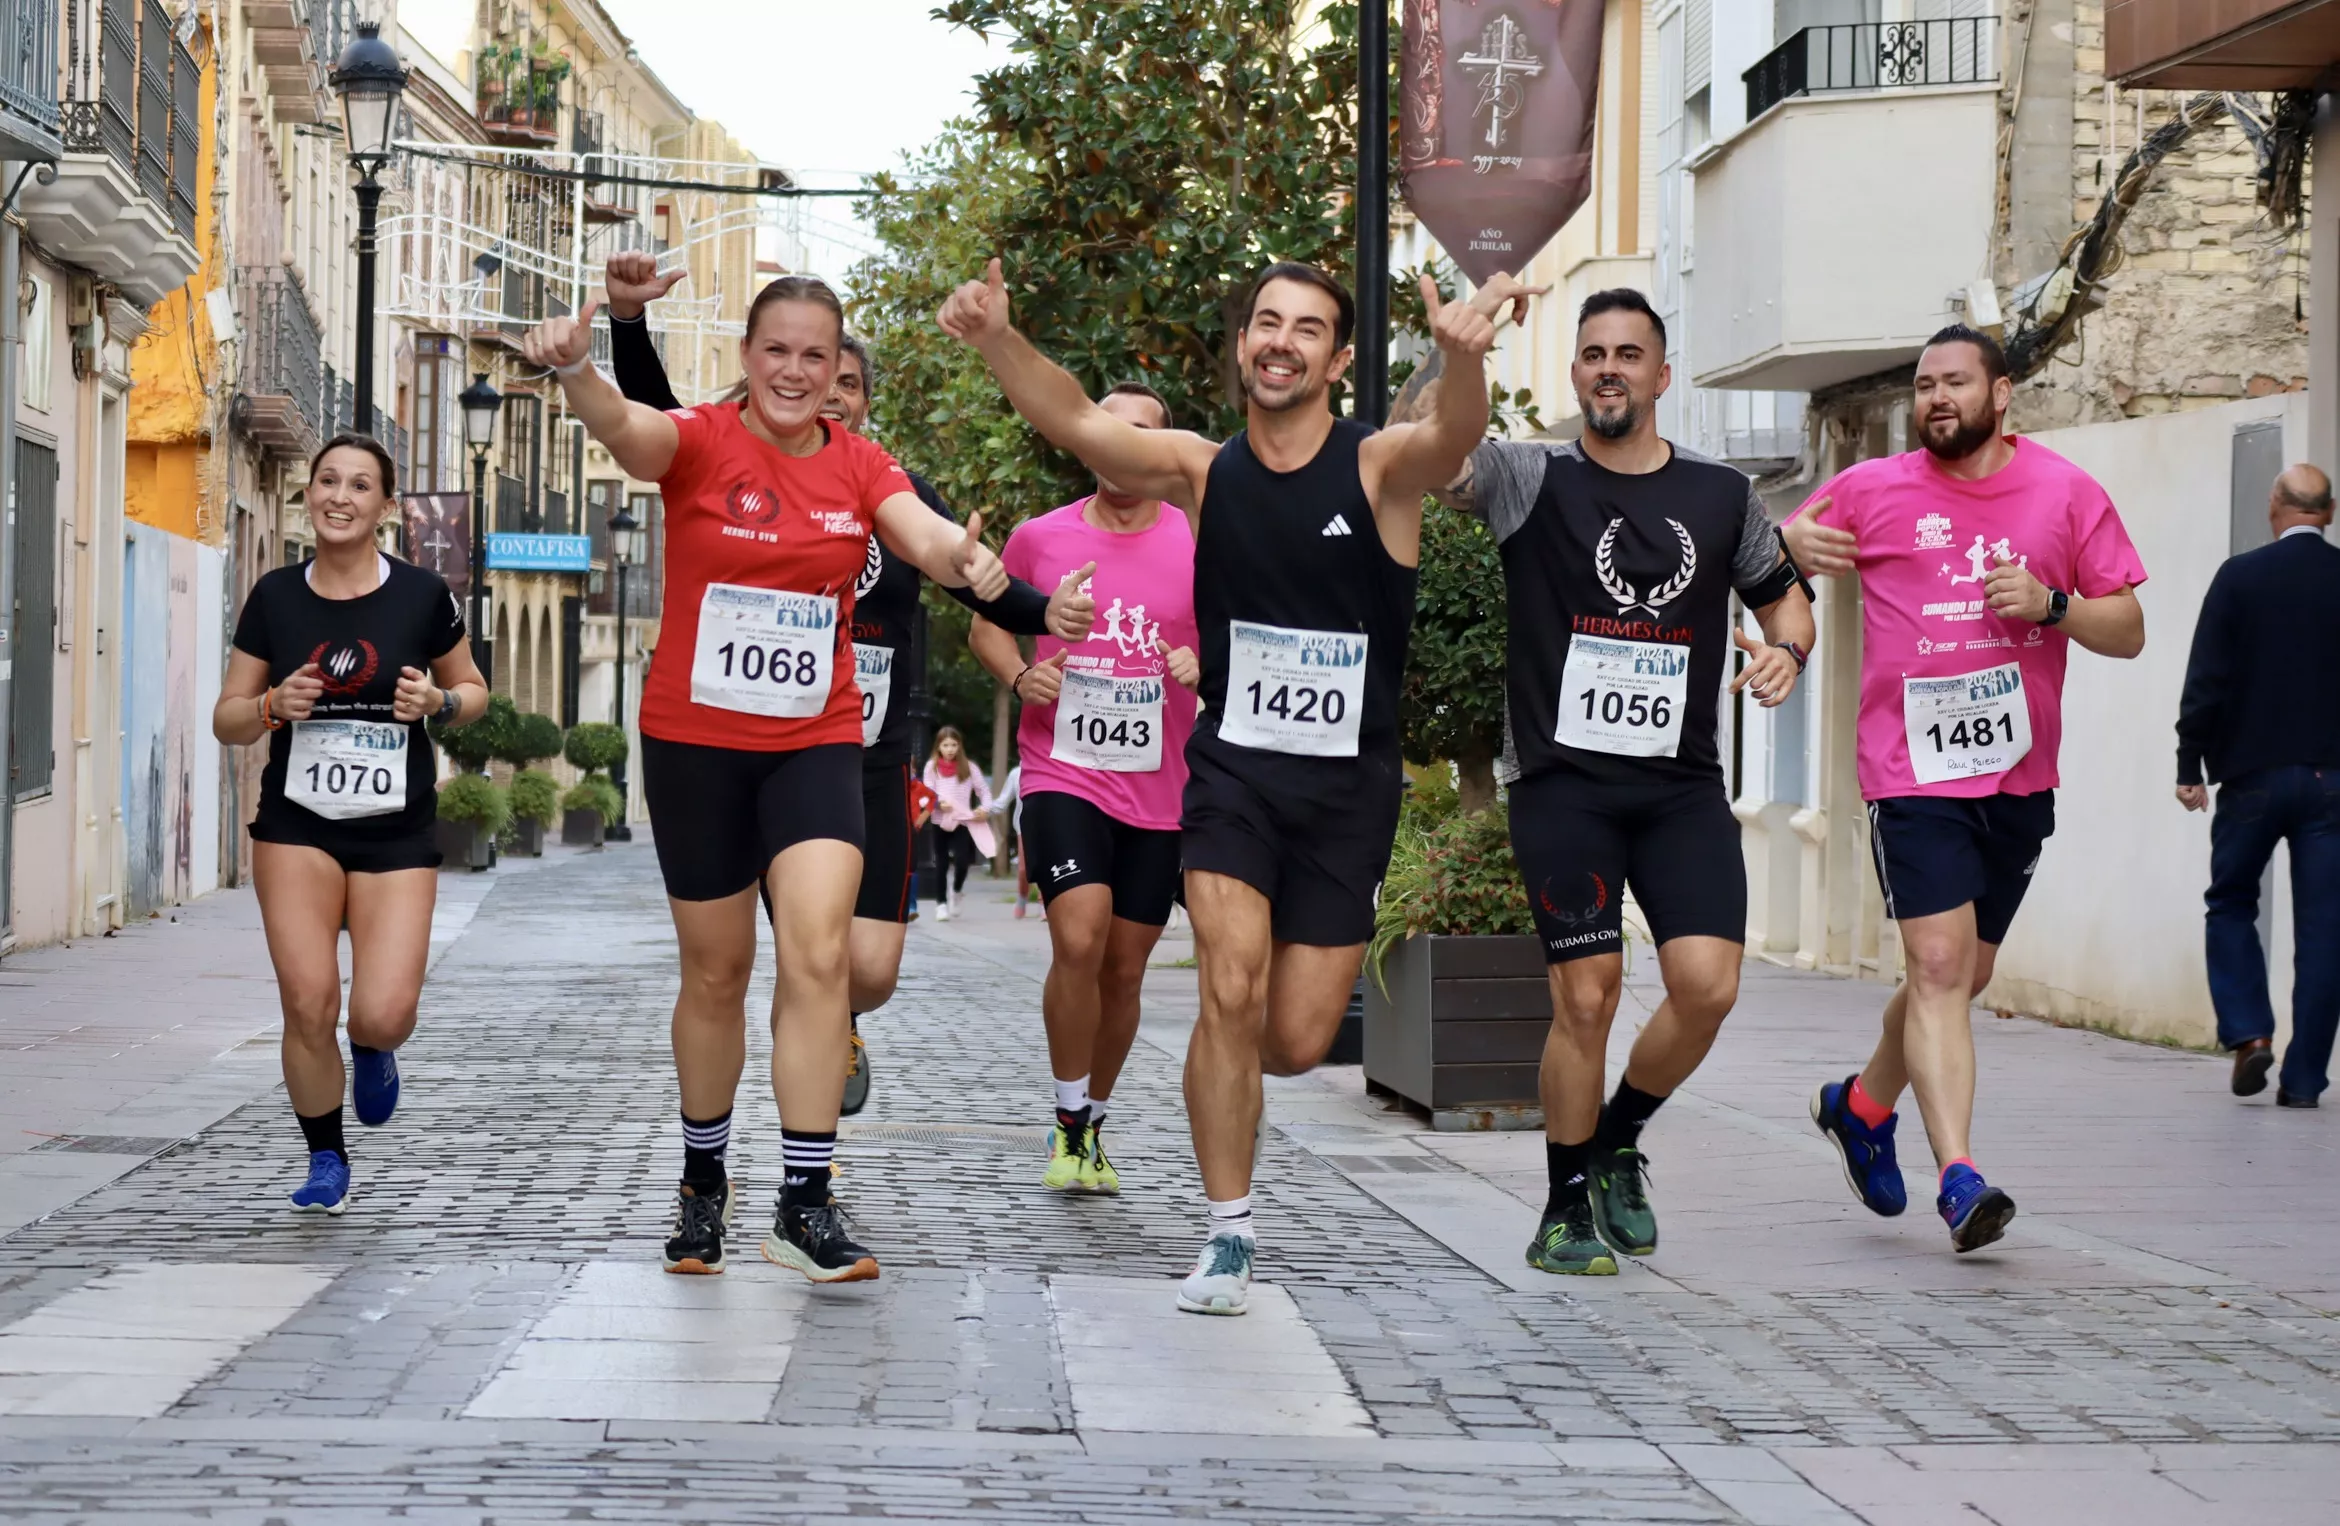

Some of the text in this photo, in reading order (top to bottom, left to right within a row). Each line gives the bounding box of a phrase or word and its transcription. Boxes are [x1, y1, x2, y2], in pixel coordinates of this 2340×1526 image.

[1479, 227, 1503, 239] AÑO
[1468, 240, 1513, 251] JUBILAR
[810, 510, 824, 520] LA
[758, 531, 778, 543] GYM
[1914, 534, 1952, 544] LUCENA
[490, 538, 585, 557] CONTAFISA
[777, 595, 811, 610] 2024
[1922, 600, 1985, 616] SUMANDO KM
[850, 622, 884, 638] GYM
[1571, 614, 1652, 638] HERMES
[1301, 635, 1336, 650] 2024
[853, 647, 876, 660] 024
[1635, 646, 1664, 660] 2024
[718, 641, 817, 687] 1068
[1064, 655, 1116, 669] UMANDO KM
[1114, 679, 1142, 692] 2024
[1967, 671, 1997, 689] 2024
[1247, 680, 1345, 725] 1420
[1580, 688, 1671, 729] 1056
[1071, 713, 1150, 748] 1043
[1926, 712, 2013, 753] 1481
[305, 762, 392, 795] 1070
[1550, 929, 1619, 950] HERMES GYM
